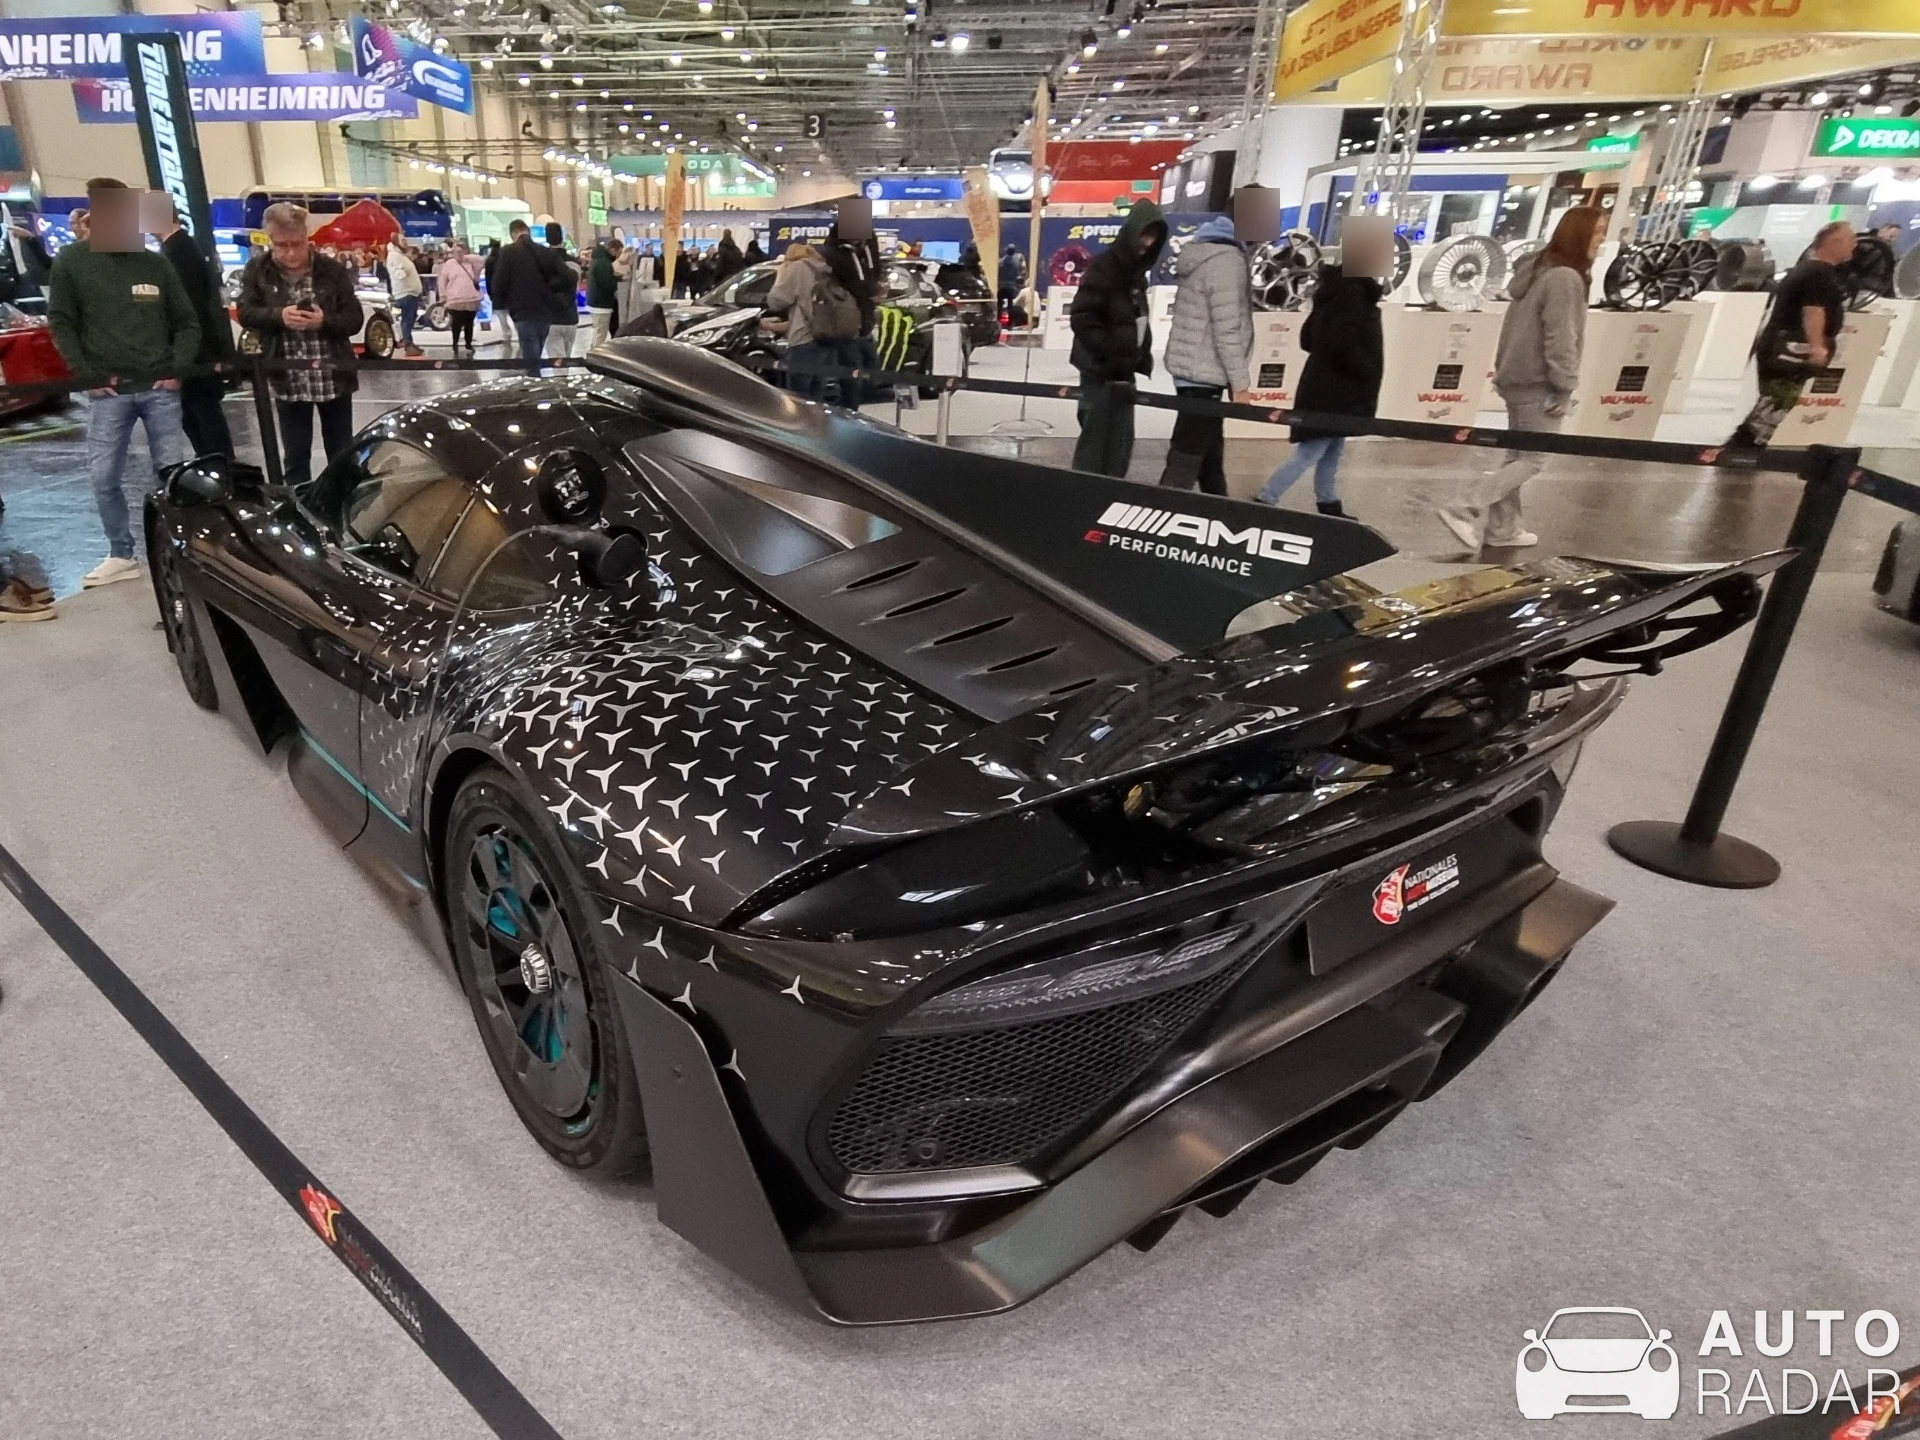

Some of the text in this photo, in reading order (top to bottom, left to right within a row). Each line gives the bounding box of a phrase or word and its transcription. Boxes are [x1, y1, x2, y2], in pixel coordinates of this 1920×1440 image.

[102, 84, 386, 112] HOENHEIMRING
[808, 114, 820, 136] 3
[1857, 129, 1920, 148] DEKRA
[1109, 534, 1253, 577] PERFORMANCE
[1405, 853, 1458, 889] NATIONALES
